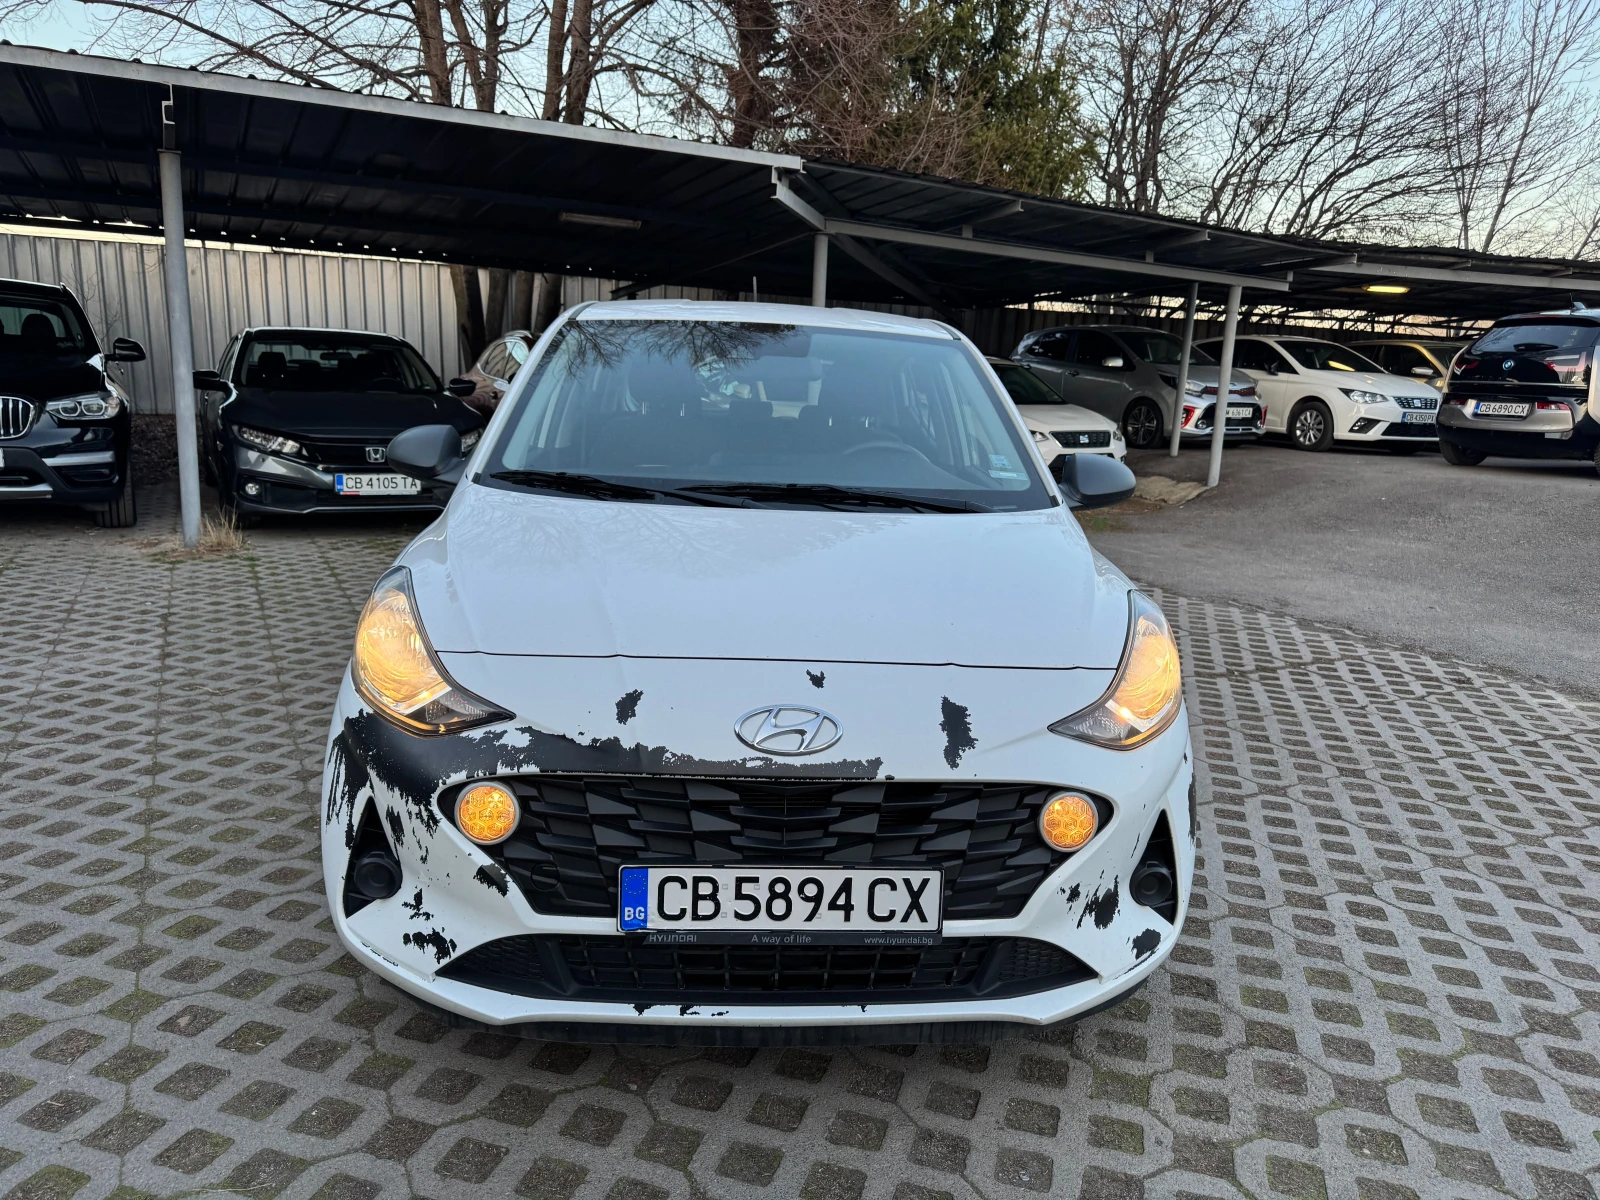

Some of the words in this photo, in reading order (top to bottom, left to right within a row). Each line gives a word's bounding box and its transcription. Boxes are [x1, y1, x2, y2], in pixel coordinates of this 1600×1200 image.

[1480, 404, 1491, 413] CB
[1491, 404, 1513, 414] 6890
[1514, 405, 1527, 415] CX
[345, 477, 363, 489] CB
[366, 477, 398, 489] 4105
[401, 477, 418, 489] TA
[657, 875, 721, 921] CB
[733, 875, 855, 922] 5894
[867, 877, 931, 923] CX
[624, 906, 645, 921] BG
[649, 934, 697, 943] HYUNDAI
[751, 934, 759, 943] A
[761, 936, 780, 945] way
[784, 934, 795, 943] of
[796, 934, 812, 943] life
